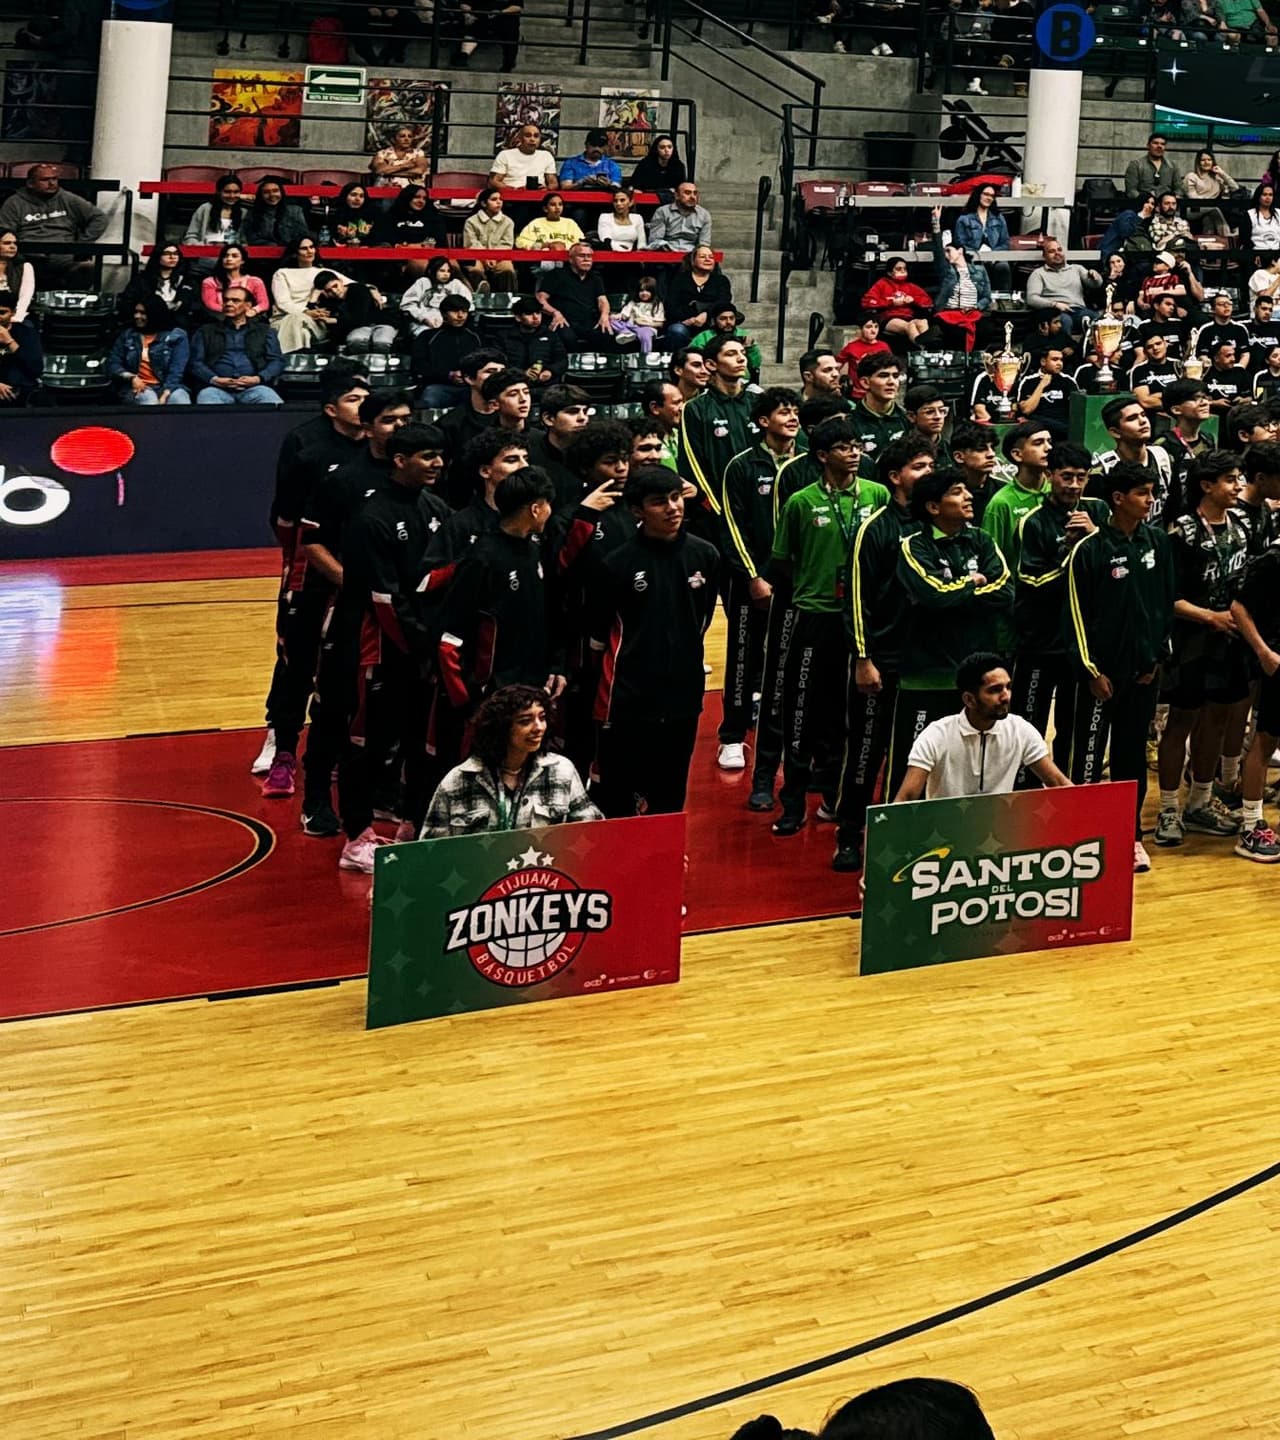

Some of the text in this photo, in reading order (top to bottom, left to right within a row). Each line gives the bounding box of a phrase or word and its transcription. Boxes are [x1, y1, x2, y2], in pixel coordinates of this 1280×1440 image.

[1050, 11, 1081, 56] B
[497, 872, 560, 895] TIJUANA
[912, 841, 1100, 900] SANTOS
[991, 884, 1014, 894] DEL
[446, 892, 609, 951] ZONKEYS
[931, 887, 1079, 935] POTOSI
[476, 944, 576, 985] BASQUETBOL
